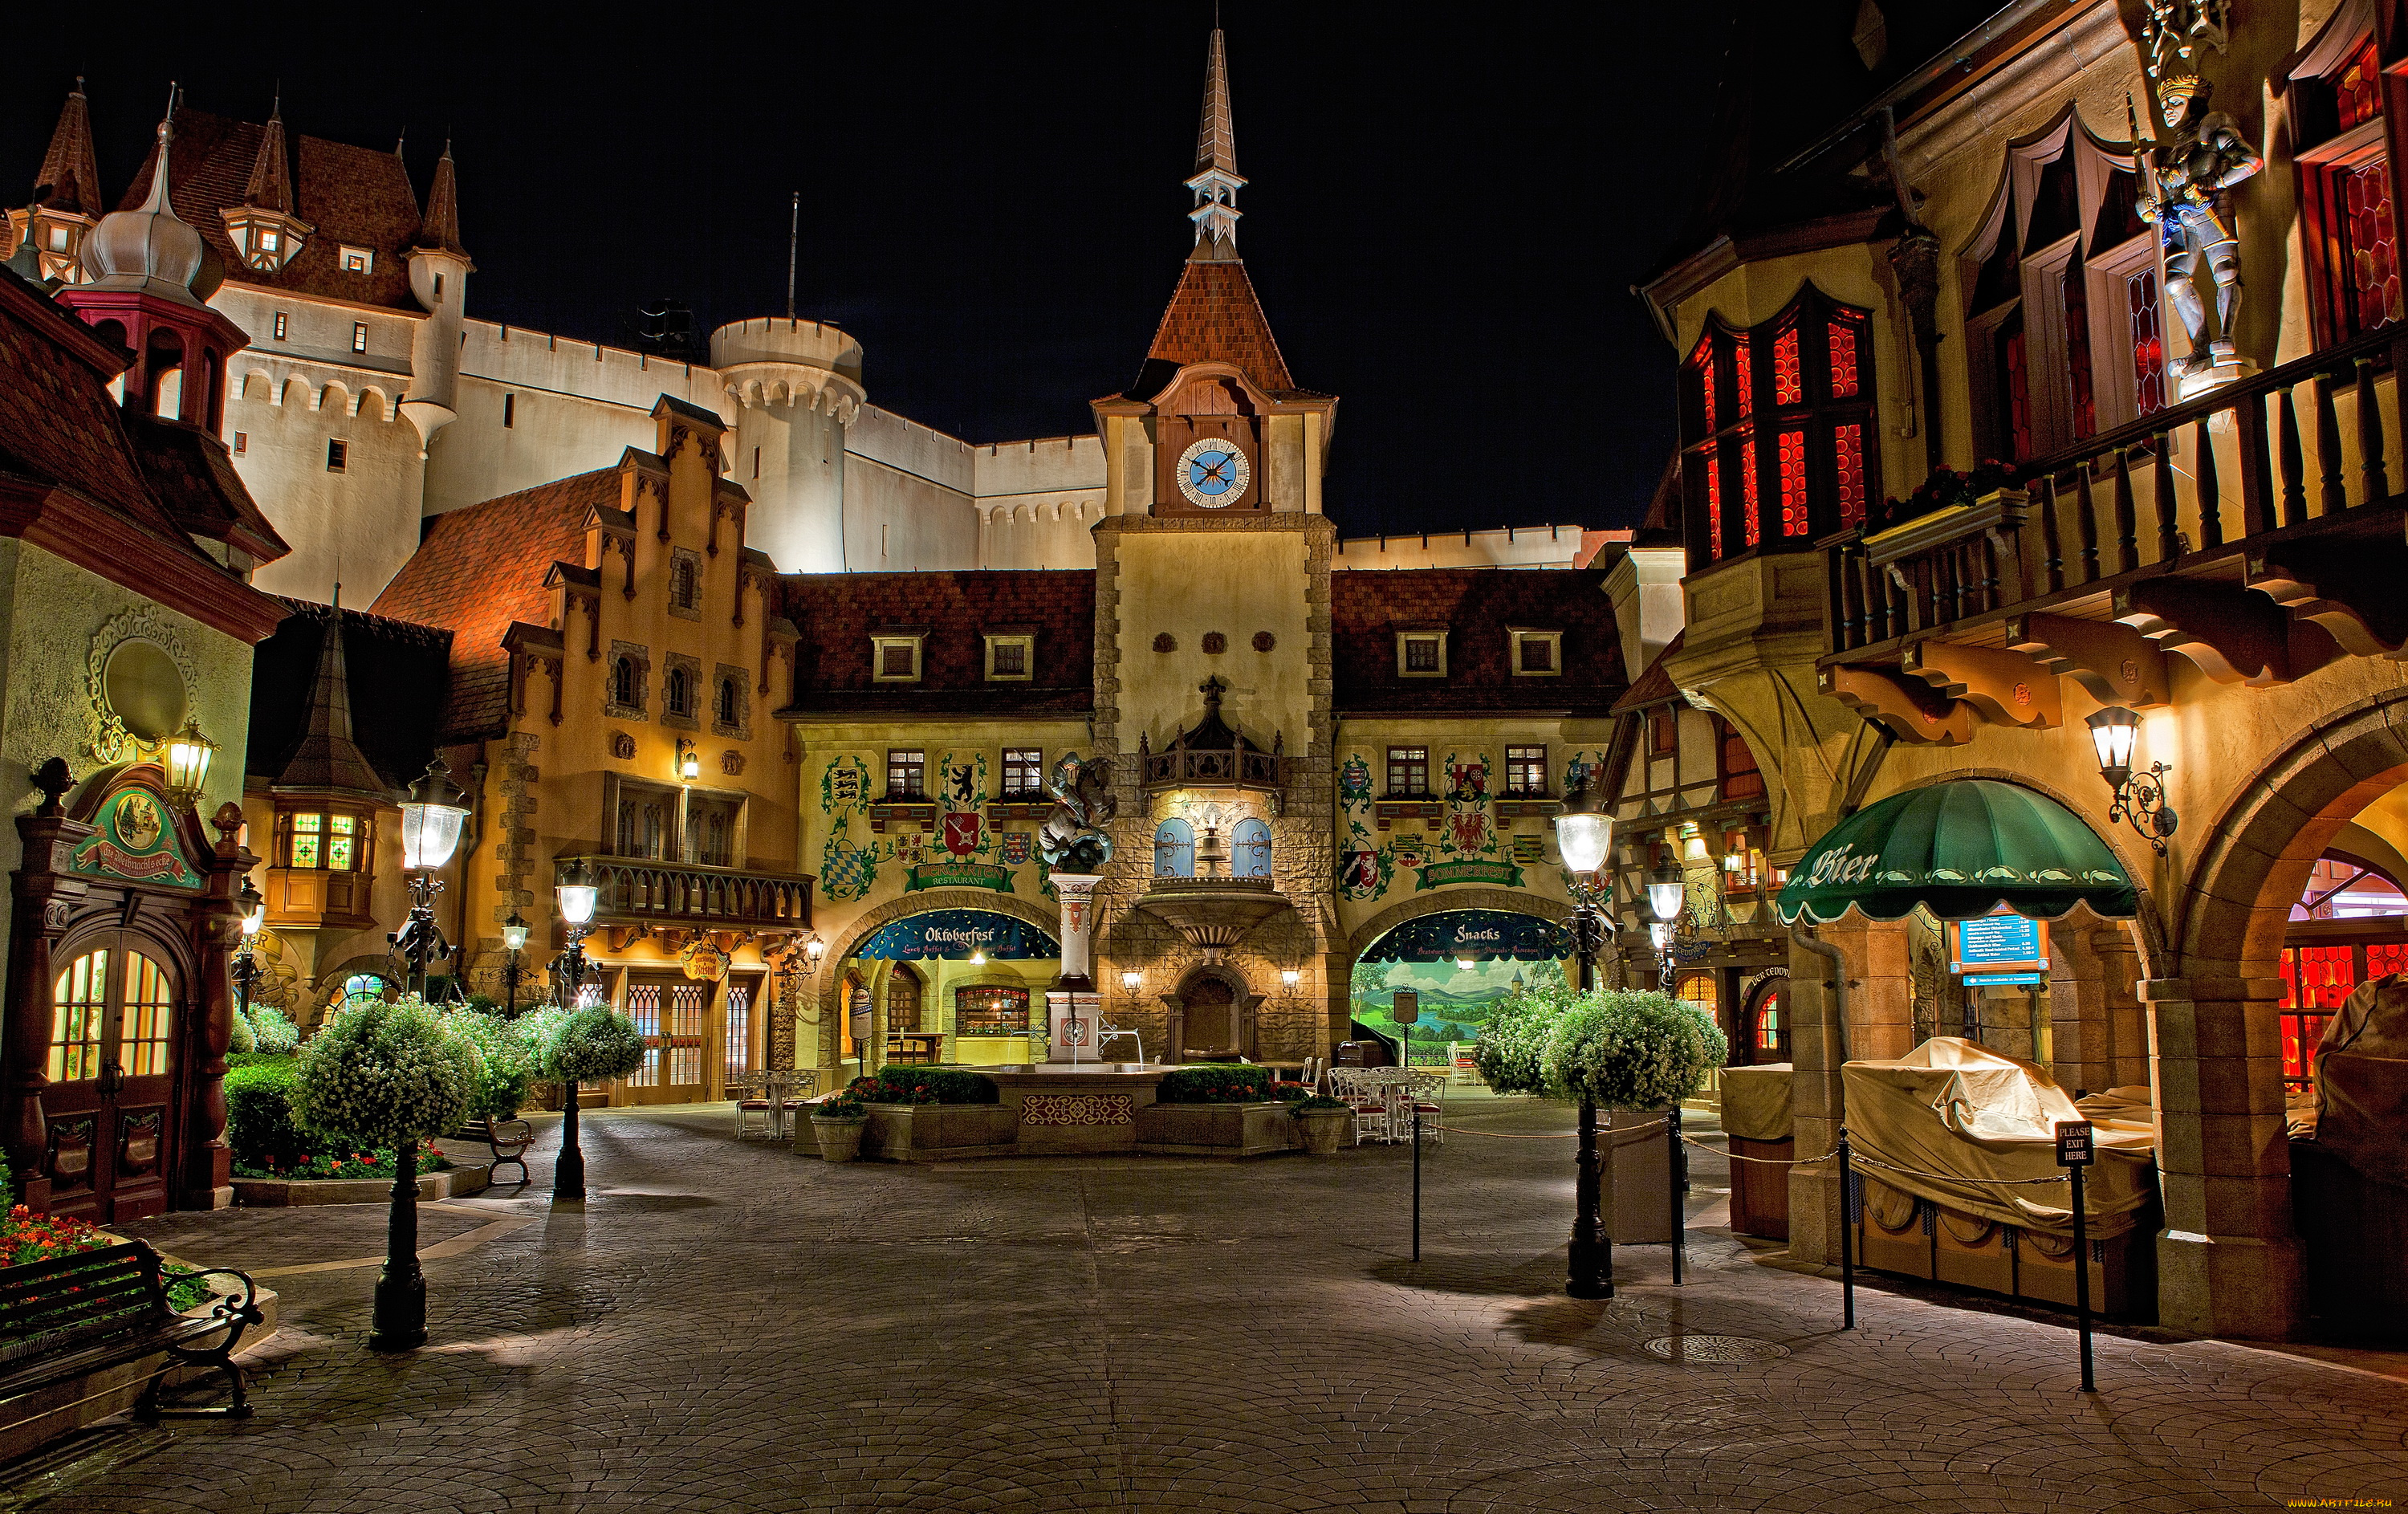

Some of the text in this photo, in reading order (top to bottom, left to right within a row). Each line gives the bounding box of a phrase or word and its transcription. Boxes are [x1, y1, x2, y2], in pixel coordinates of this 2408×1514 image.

[104, 845, 114, 858] die
[120, 867, 144, 876] CHRISTMAS
[144, 867, 160, 876] CORNER
[917, 863, 1005, 880] BIERGARTEN
[1805, 843, 1879, 888] Bier
[1427, 865, 1513, 882] SOMMERFEST
[933, 877, 986, 885] RESTAURANT
[925, 926, 995, 947] Oktoberfest
[1454, 924, 1500, 943] Snacks
[902, 944, 921, 954] Lunch
[922, 944, 942, 954] Buffet
[996, 944, 1016, 954] Buffet
[1484, 946, 1508, 954] Pretzels
[1751, 967, 1790, 987] DER TEDDY
[2059, 1127, 2090, 1137] PLEASE
[2066, 1139, 2085, 1149] EXIT
[2064, 1150, 2087, 1161] HERE
